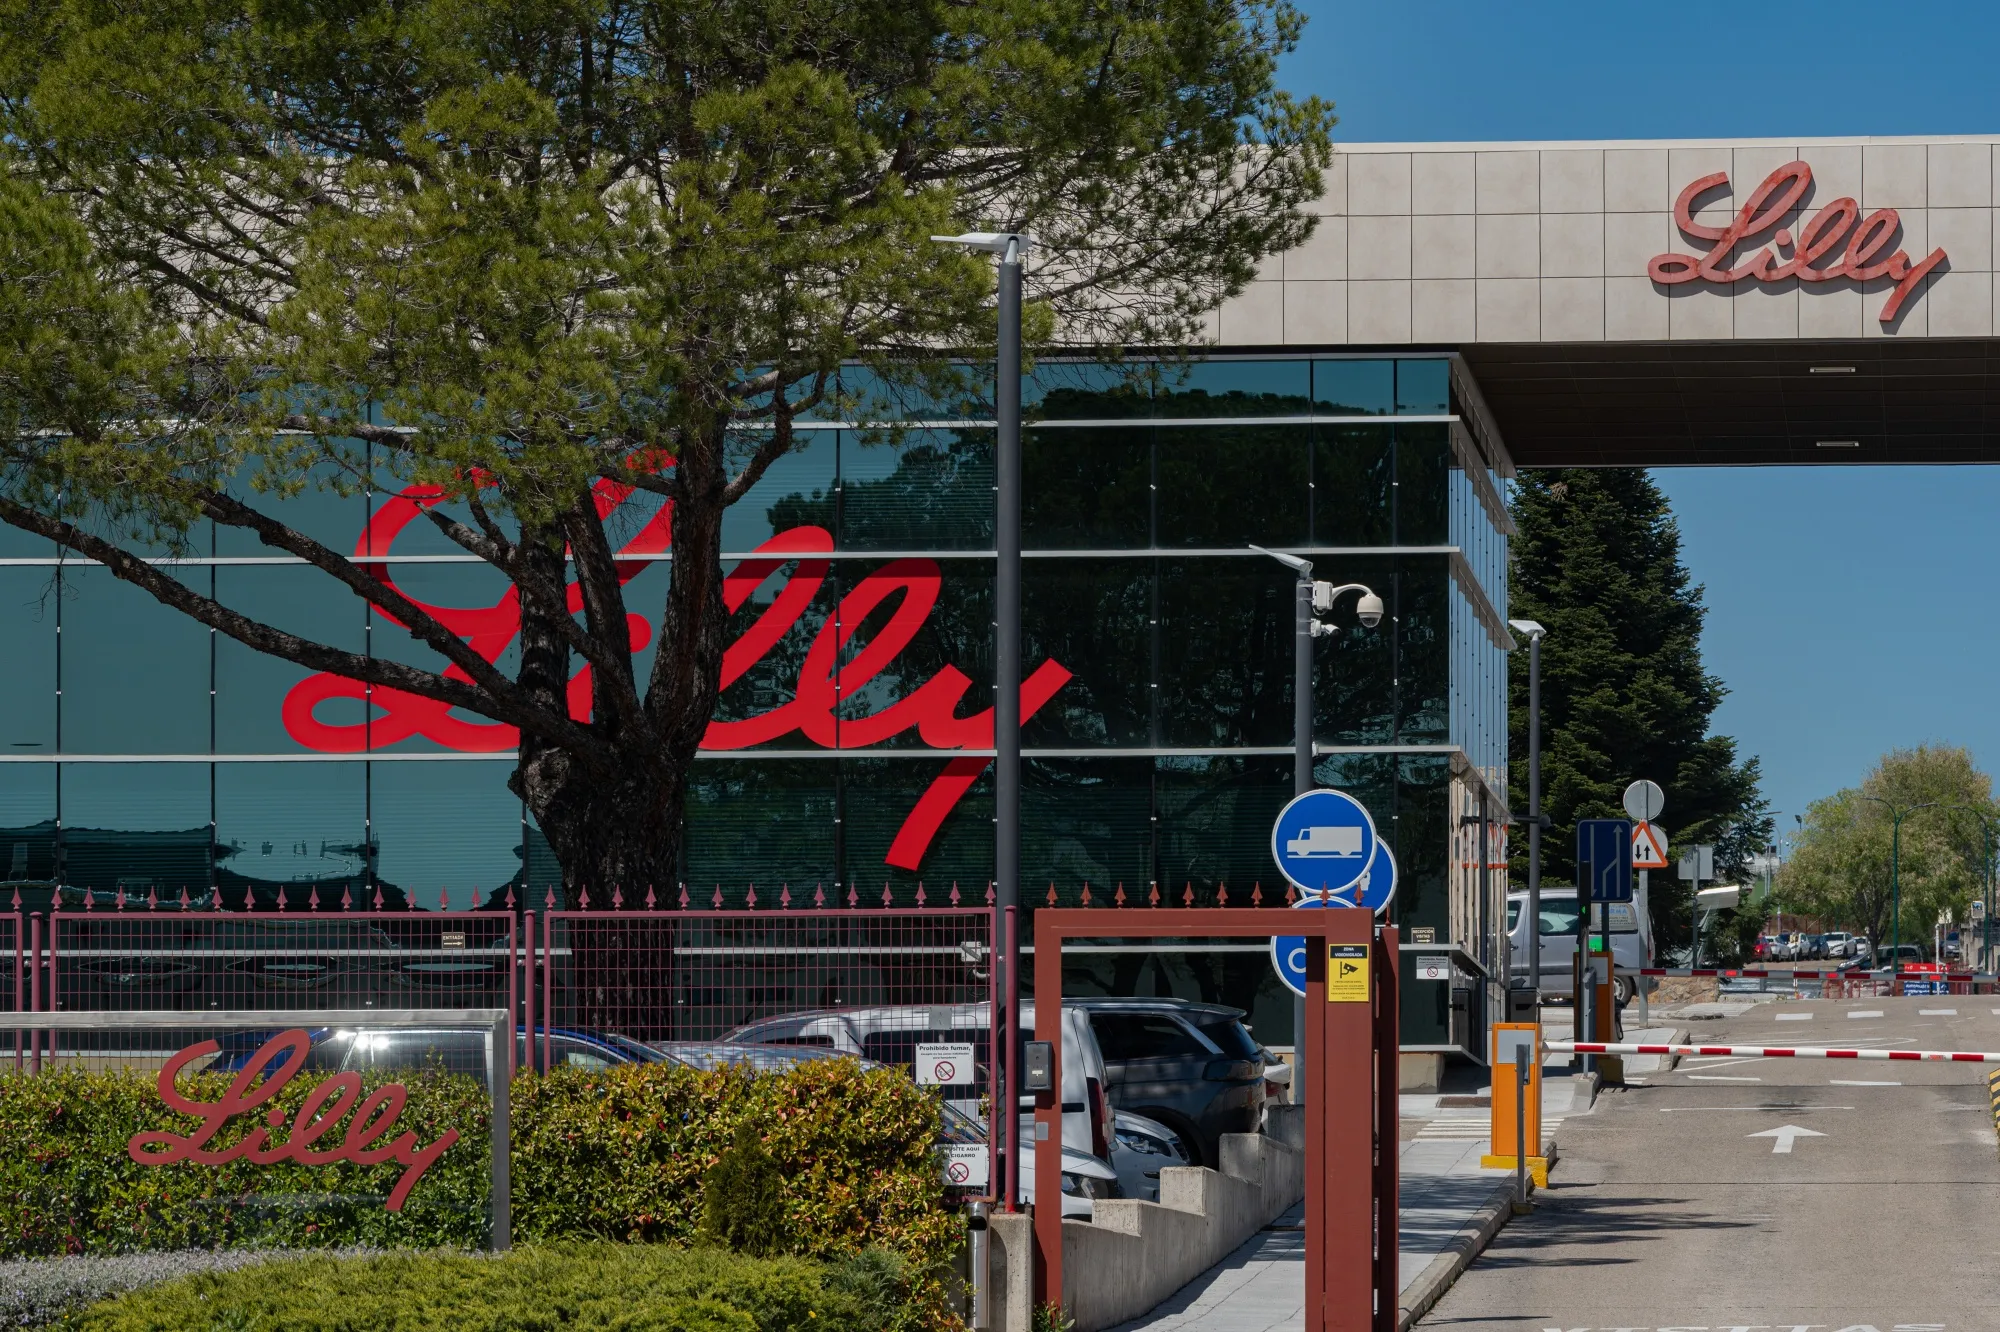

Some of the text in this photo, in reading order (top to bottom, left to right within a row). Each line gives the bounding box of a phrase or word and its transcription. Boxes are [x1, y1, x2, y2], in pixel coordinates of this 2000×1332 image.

[1648, 161, 1947, 321] Lilly
[282, 449, 1073, 871] Lilly
[128, 1029, 459, 1211] Lilly
